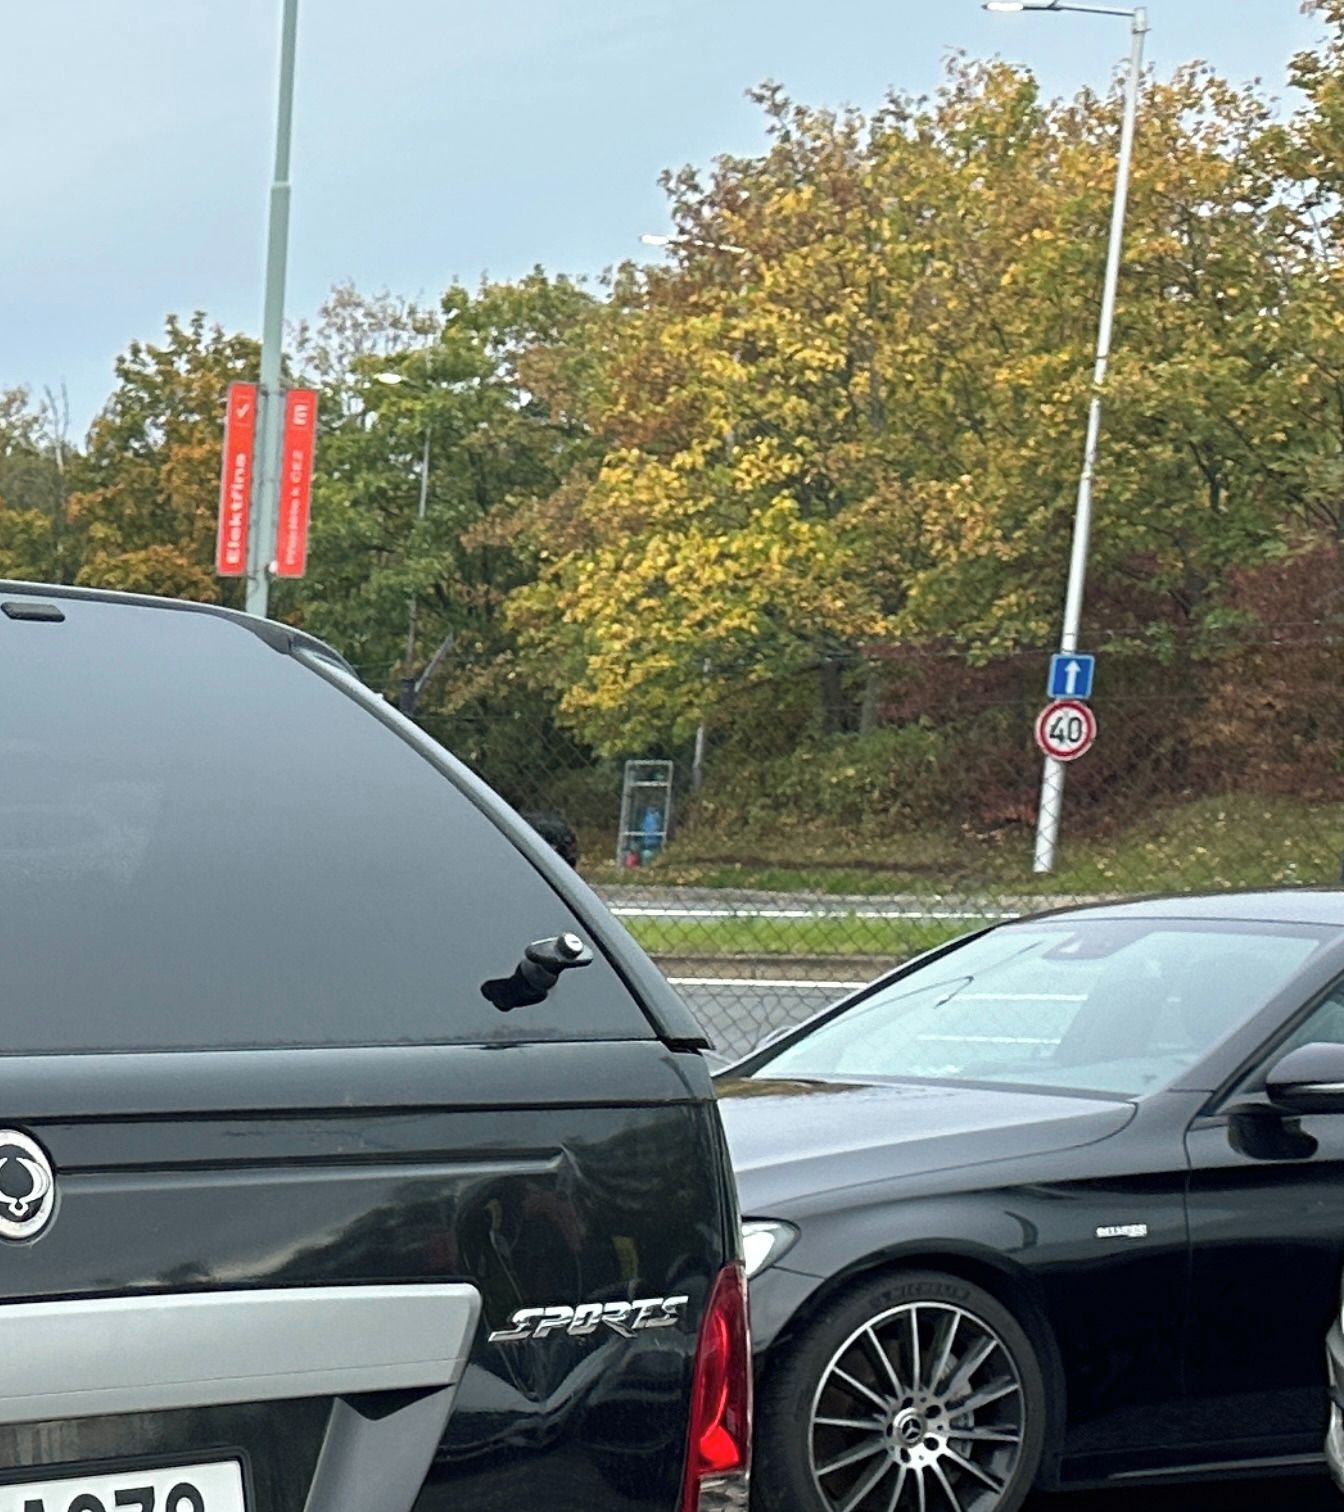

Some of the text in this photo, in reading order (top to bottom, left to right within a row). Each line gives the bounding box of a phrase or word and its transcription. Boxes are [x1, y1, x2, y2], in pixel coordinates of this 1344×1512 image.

[225, 452, 247, 564] Elektřina
[1049, 716, 1083, 744] 40
[488, 1295, 690, 1343] SPORTS
